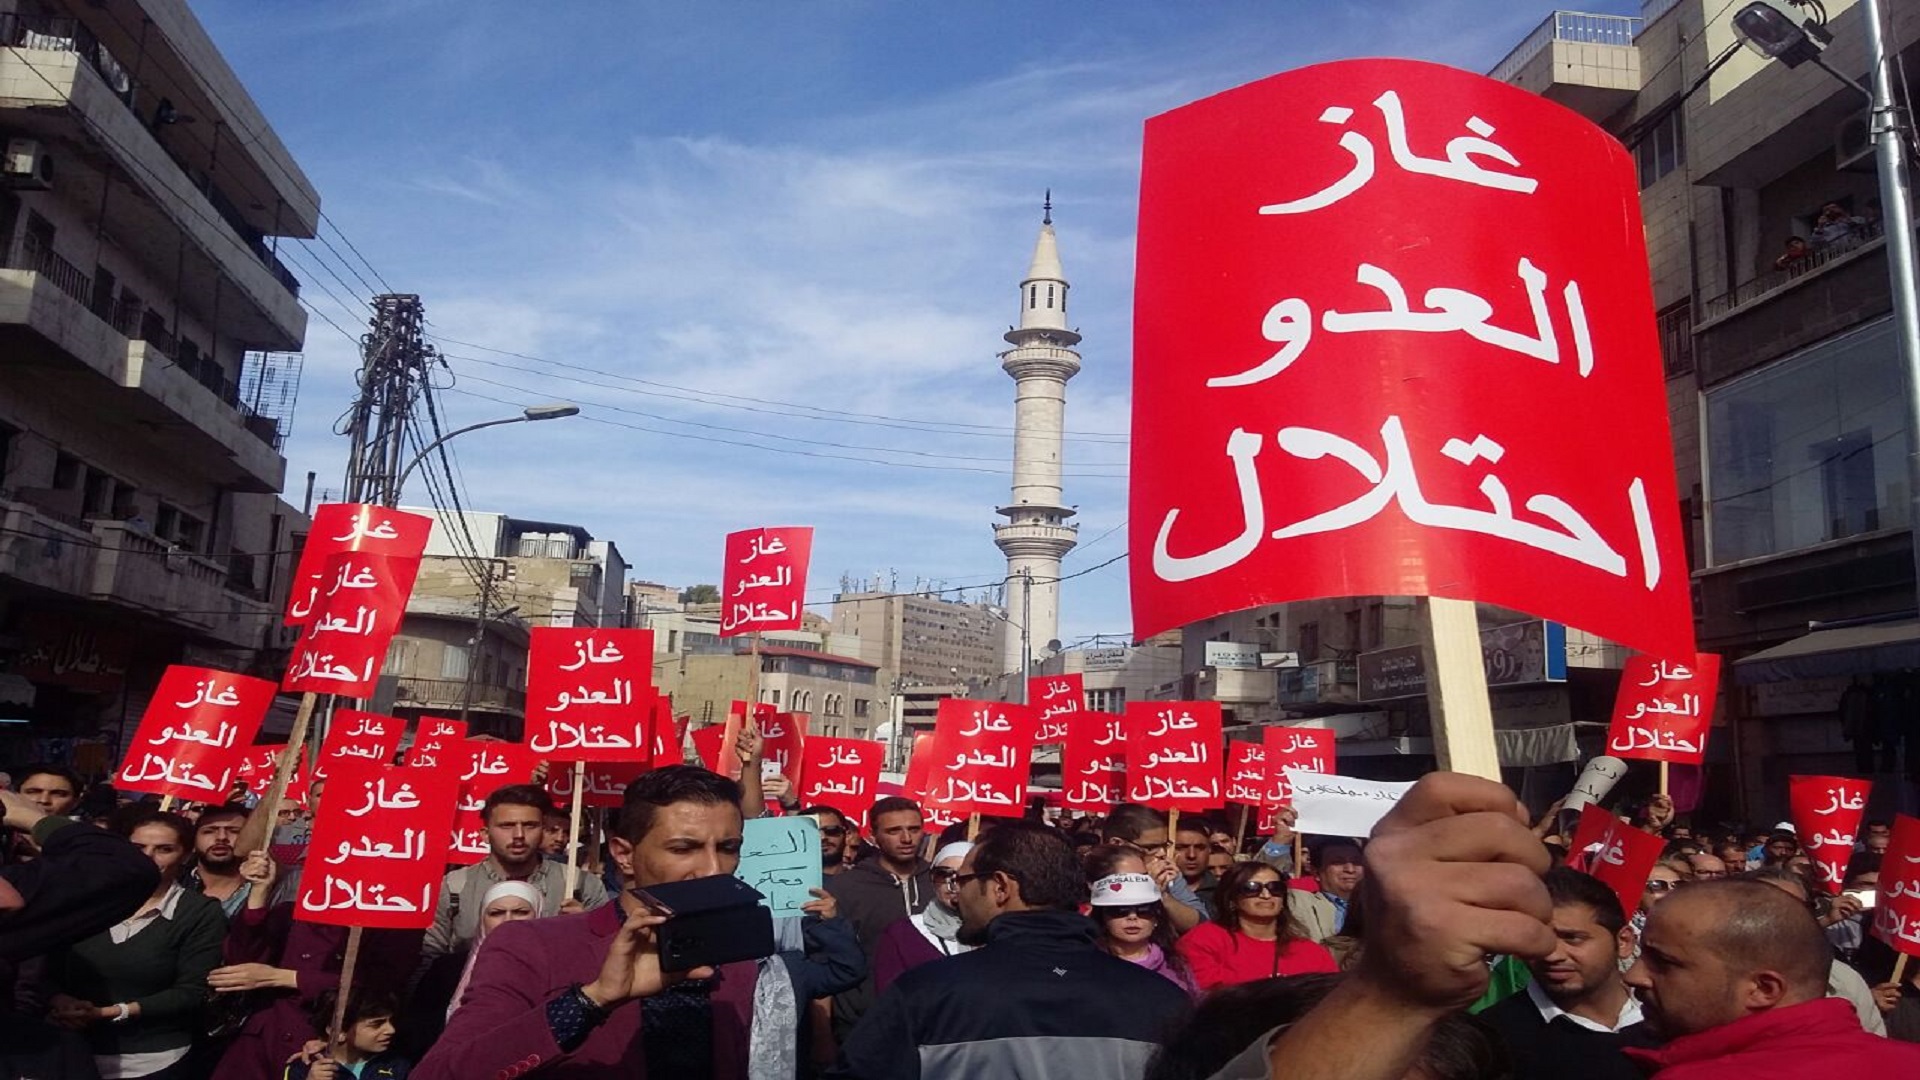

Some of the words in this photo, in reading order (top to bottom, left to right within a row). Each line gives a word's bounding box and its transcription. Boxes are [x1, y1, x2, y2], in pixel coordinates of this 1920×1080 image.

[1259, 90, 1538, 214] غاز
[1206, 257, 1593, 387] العدو
[1153, 415, 1660, 593] احتلال
[331, 514, 398, 542] غاز
[741, 536, 786, 563] غاز
[327, 563, 377, 595] غاز
[732, 566, 791, 596] العدو
[721, 598, 797, 631] احتلال
[560, 638, 623, 671] غاز
[1640, 660, 1692, 686] غاز
[176, 679, 239, 708] غاز
[546, 678, 631, 711] العدو
[1043, 681, 1070, 699] غاز
[1041, 700, 1077, 720] العدو
[1626, 693, 1699, 719] العدو
[149, 722, 237, 748] العدو
[347, 719, 384, 736] غاز
[430, 723, 455, 736] غاز
[960, 709, 1011, 736] غاز
[1148, 710, 1197, 736] غاز
[531, 721, 641, 752] احتلال
[1282, 734, 1317, 753] غاز
[1612, 726, 1704, 752] احتلال
[332, 744, 384, 759] العدو
[818, 746, 861, 767] غاز
[946, 745, 1015, 770] العدو
[1141, 742, 1206, 768] العدو
[122, 753, 230, 791] احتلال
[461, 751, 509, 780] غاز
[346, 778, 420, 816] غاز
[806, 776, 864, 796] العدو
[931, 777, 1020, 804] احتلال
[1131, 776, 1218, 801] احتلال
[1814, 787, 1863, 814] غاز
[325, 828, 425, 864] العدو
[303, 875, 430, 912] احتلال
